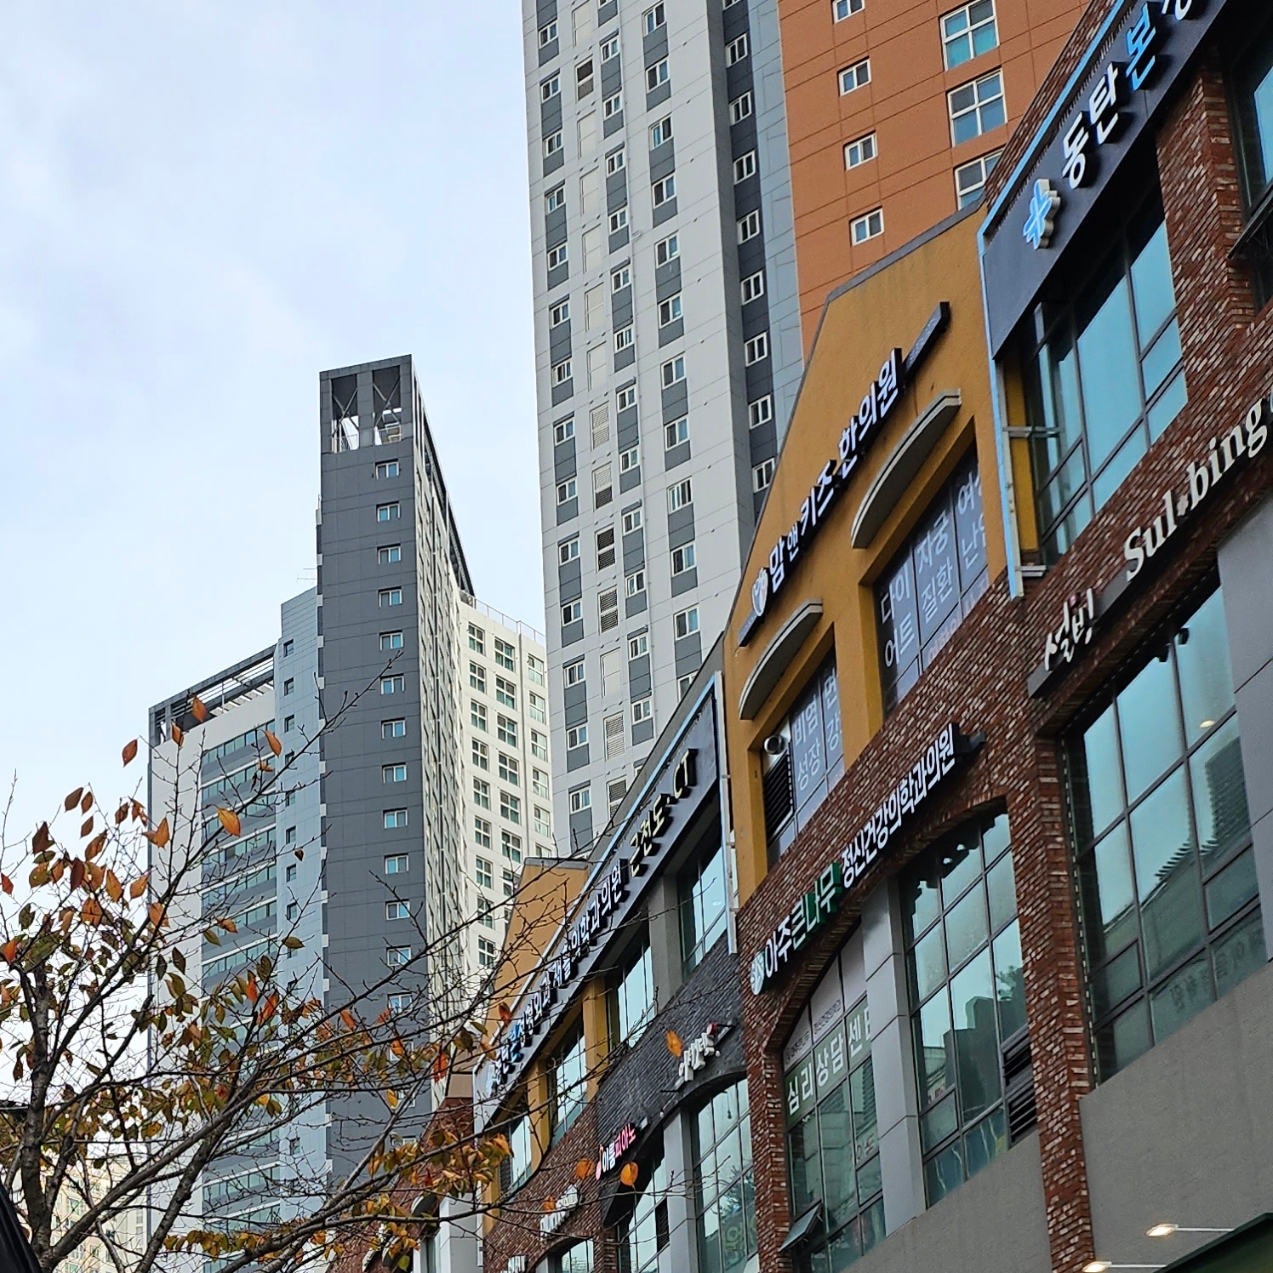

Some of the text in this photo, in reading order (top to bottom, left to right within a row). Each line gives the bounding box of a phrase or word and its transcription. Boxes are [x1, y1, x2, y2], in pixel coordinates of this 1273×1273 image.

[916, 517, 949, 576] 자궁
[921, 563, 954, 625] 질환
[793, 706, 820, 747] 비염
[796, 742, 821, 791] 성장
